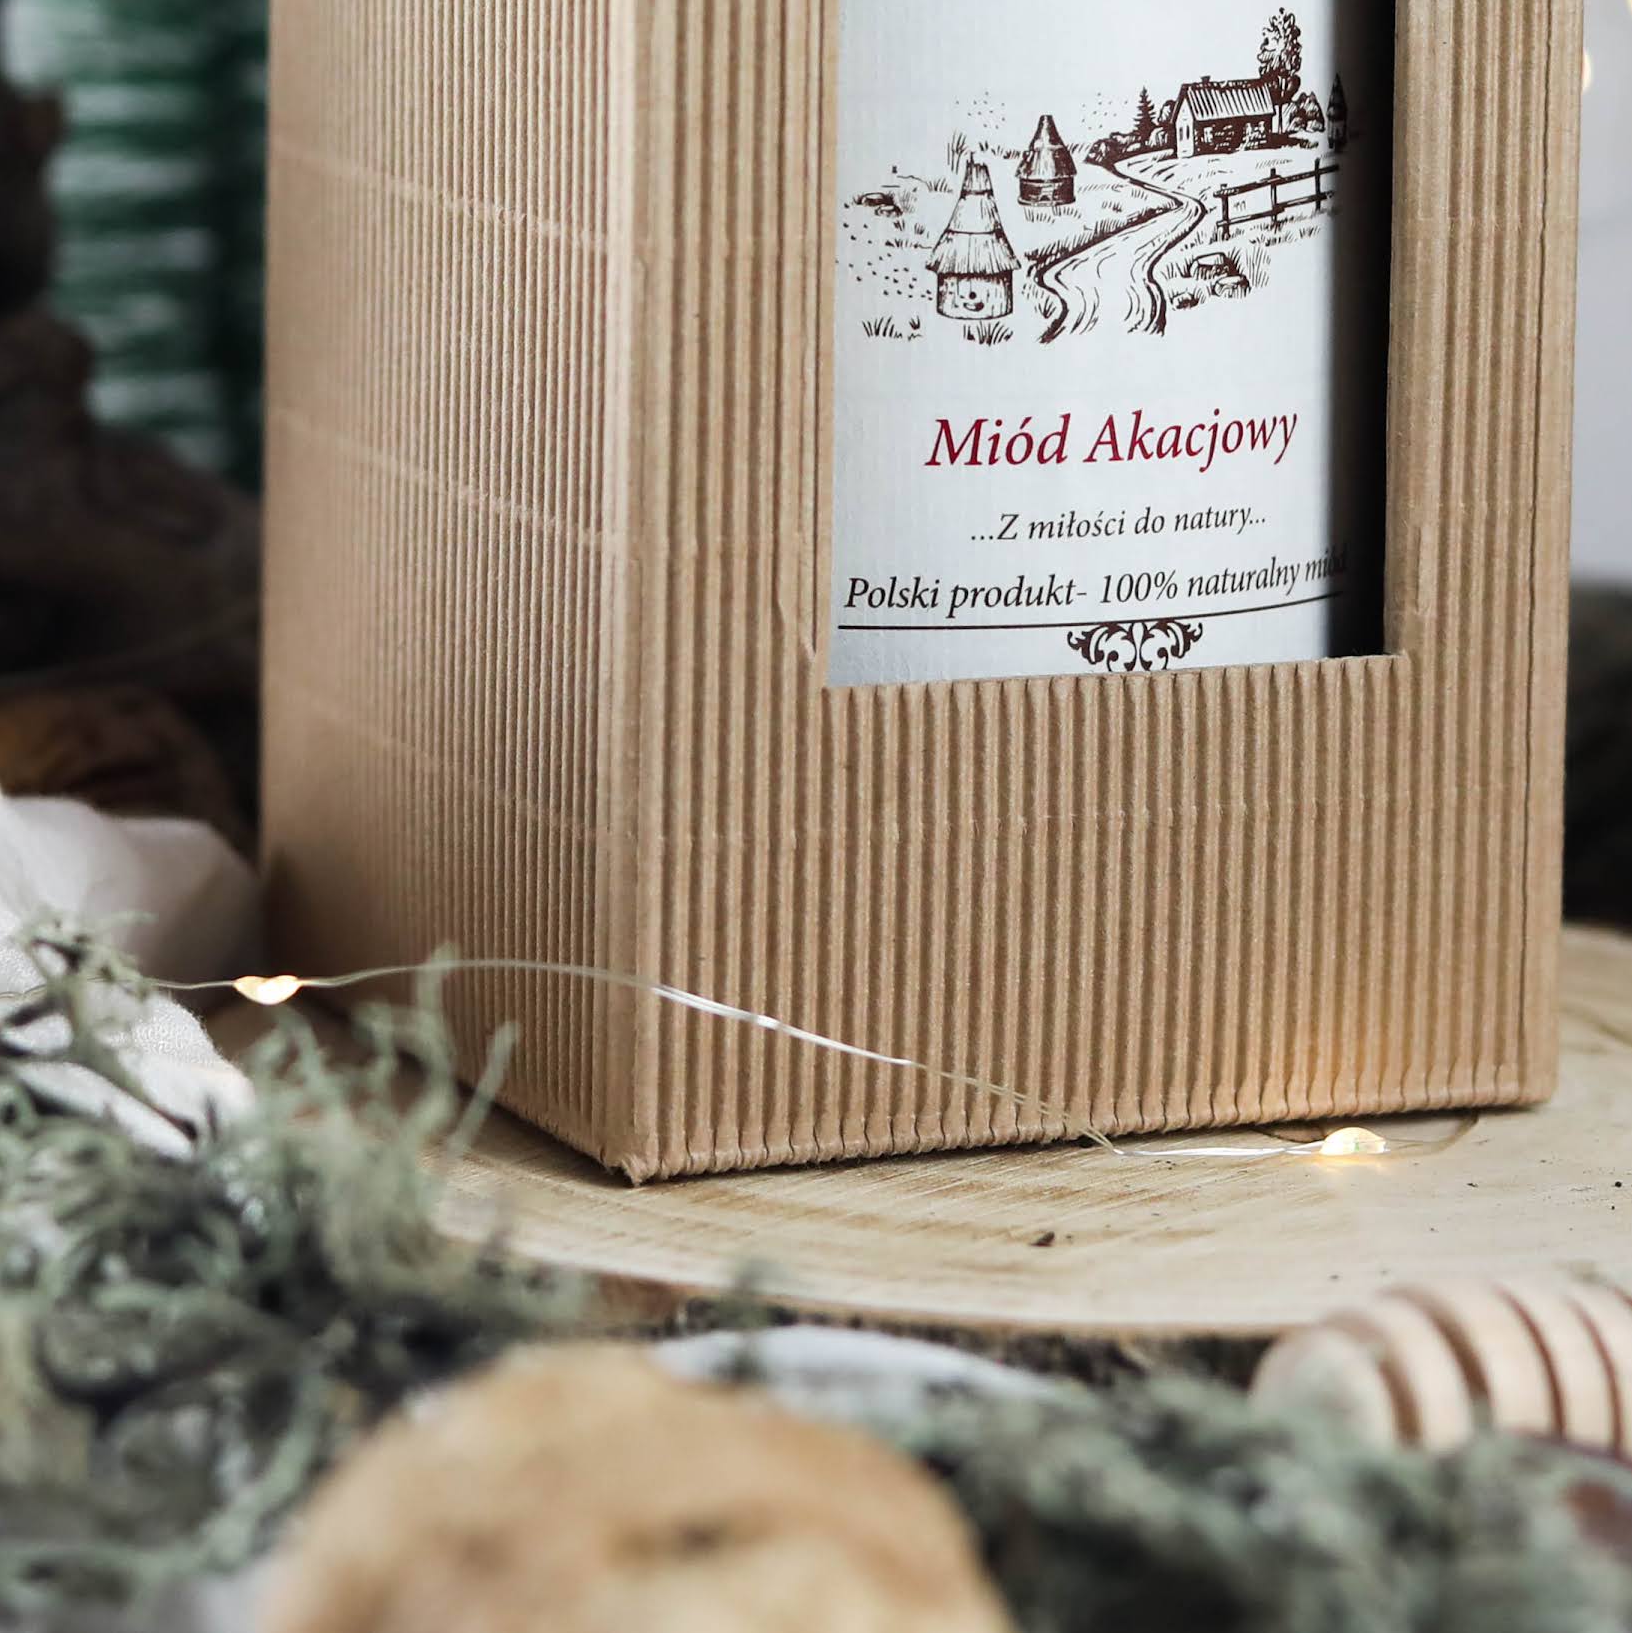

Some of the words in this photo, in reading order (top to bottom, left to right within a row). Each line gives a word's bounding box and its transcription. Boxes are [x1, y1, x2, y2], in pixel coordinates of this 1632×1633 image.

[924, 413, 1072, 467] Miód
[1083, 407, 1299, 474] Akacjowy
[970, 513, 1019, 542] ...Z
[1027, 508, 1127, 541] miłości
[1134, 505, 1166, 536] do
[1173, 503, 1268, 536] natury...
[843, 576, 940, 610] Polski
[945, 573, 1088, 620] produkt-
[1098, 569, 1180, 605] 100%
[1186, 555, 1303, 599] naturalny
